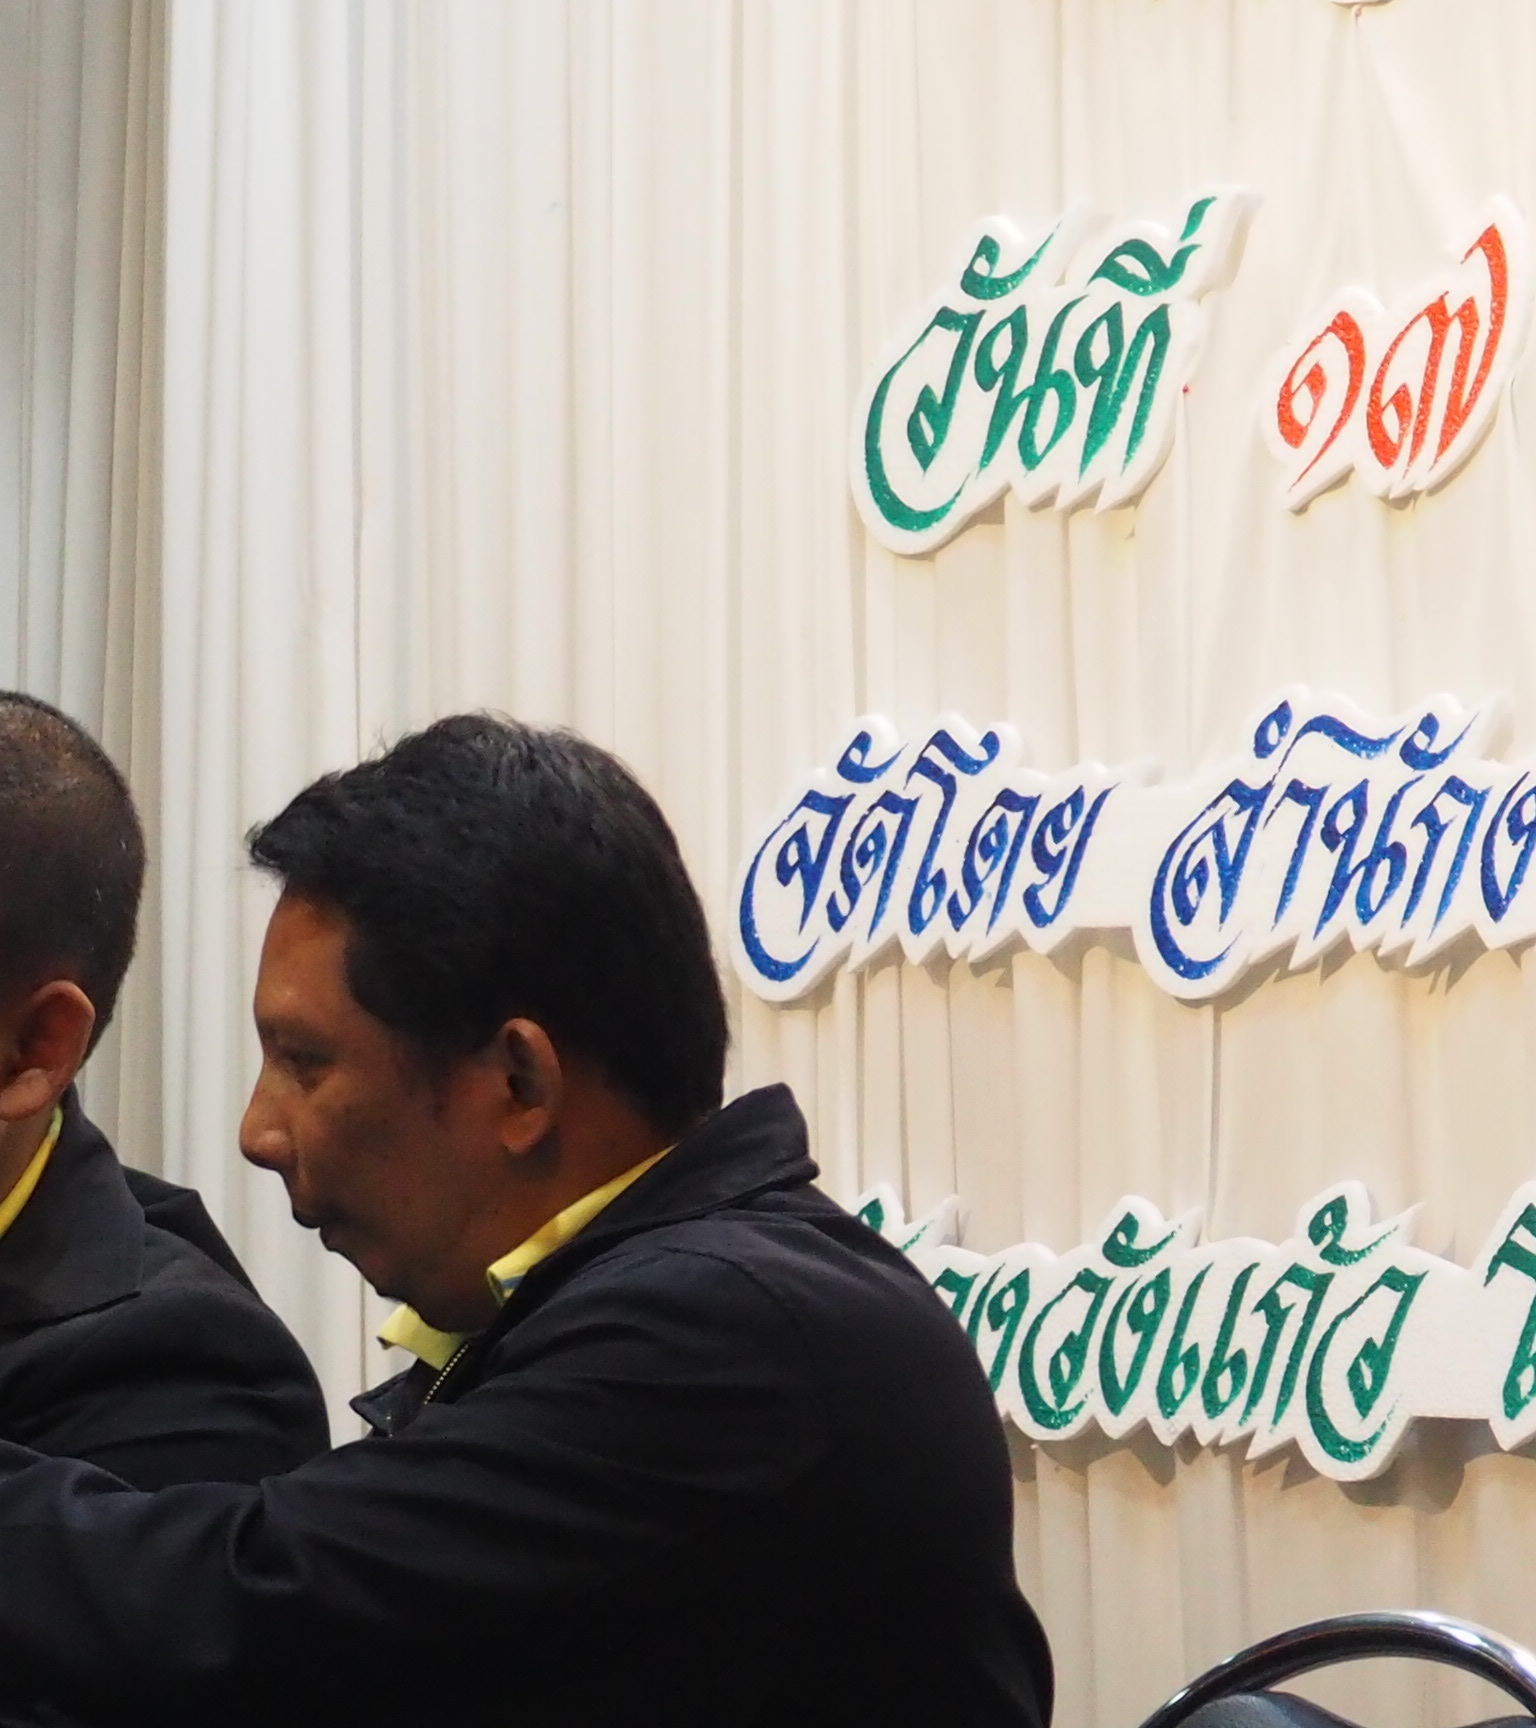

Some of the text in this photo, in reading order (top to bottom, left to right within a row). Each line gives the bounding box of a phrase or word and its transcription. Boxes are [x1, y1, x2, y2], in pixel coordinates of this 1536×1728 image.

[864, 196, 1217, 531] วันที่
[739, 729, 1121, 982] จัดโดย
